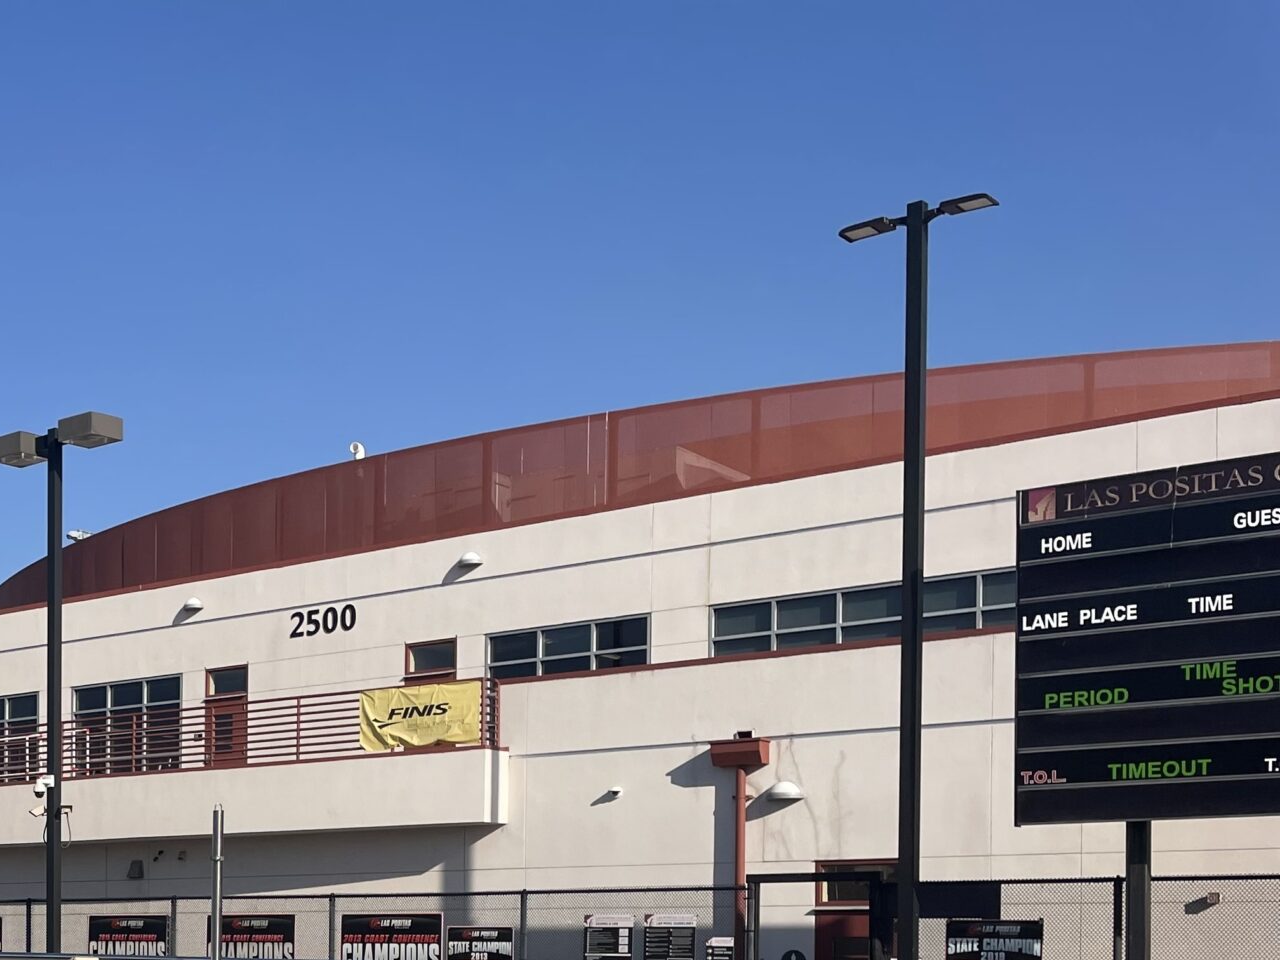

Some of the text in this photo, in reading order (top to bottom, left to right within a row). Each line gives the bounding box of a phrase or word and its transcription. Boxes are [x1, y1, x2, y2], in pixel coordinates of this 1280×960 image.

[1064, 486, 1120, 513] LAS
[1129, 465, 1263, 503] POSITAS
[1233, 507, 1280, 529] GUES
[1041, 532, 1092, 554] HOME
[289, 604, 357, 639] 2500
[1022, 594, 1233, 631] LANE PLACE TIME
[1180, 660, 1237, 681] TIME
[1044, 687, 1129, 710] PERIOD
[387, 703, 450, 721] FINIS
[1107, 758, 1212, 781] TIMEOUT
[448, 941, 512, 957] STATE CHAMPION
[471, 952, 488, 960] 2013
[947, 937, 1041, 957] STATE CHAMPION
